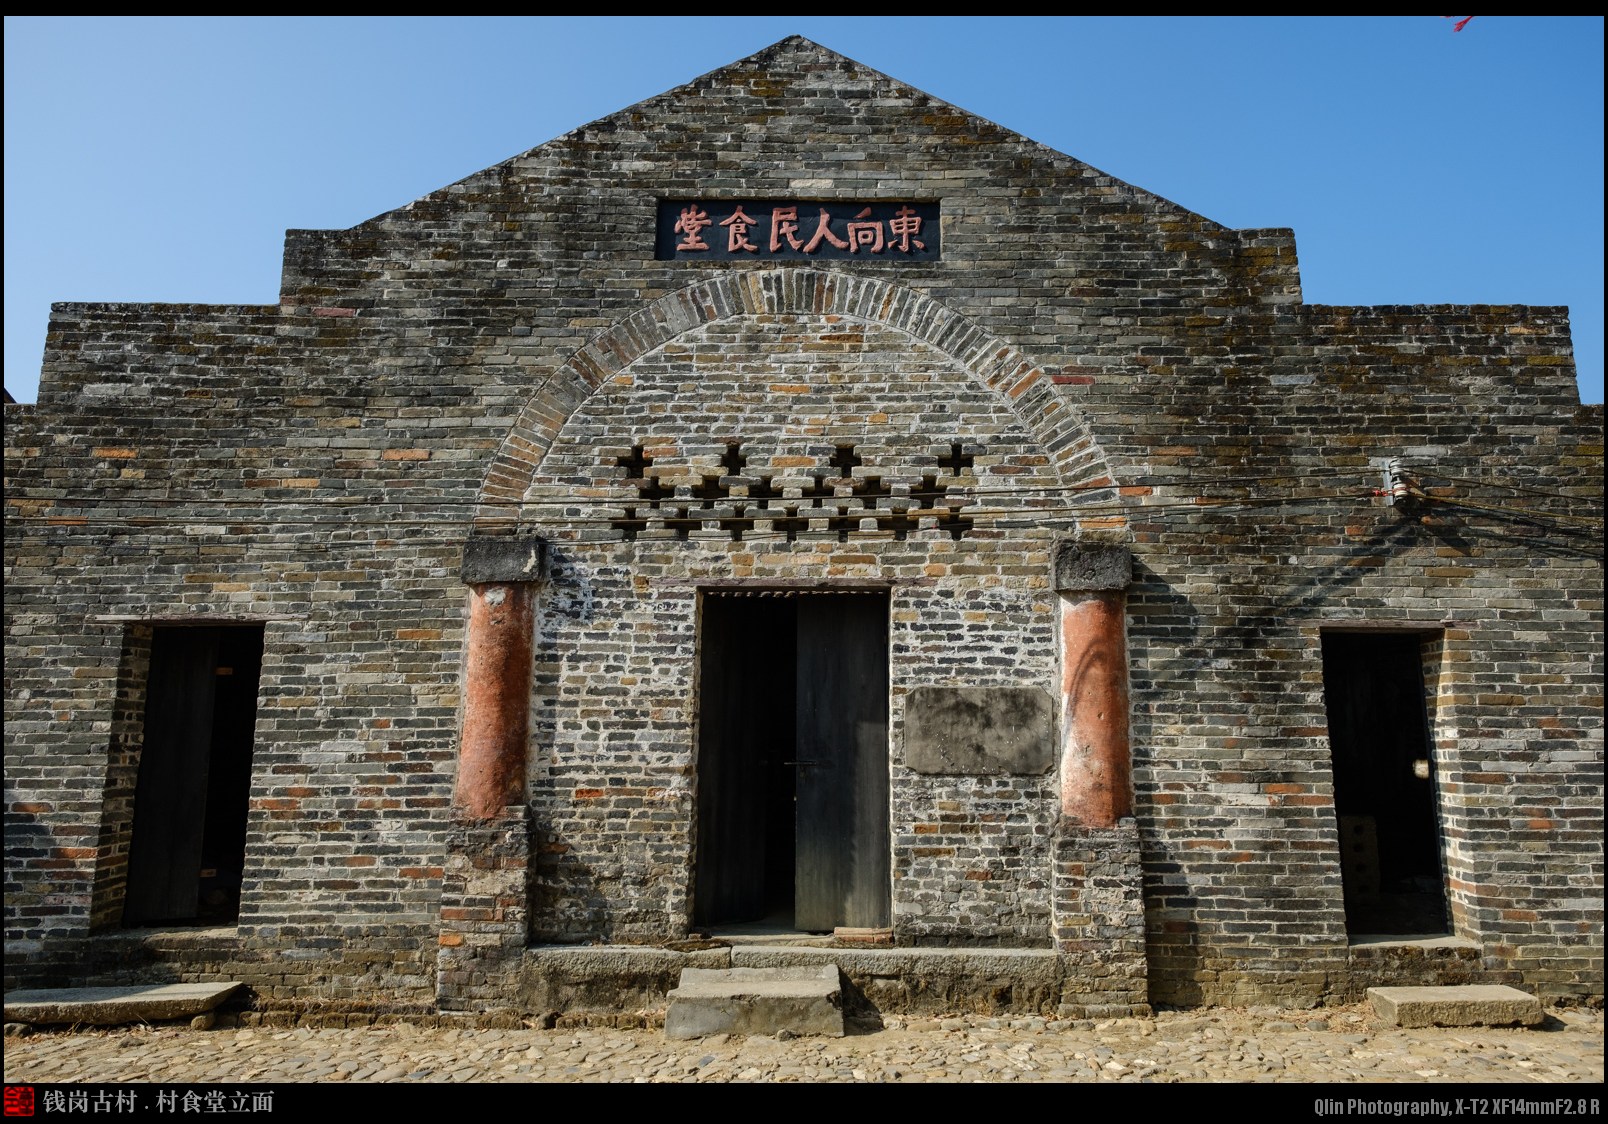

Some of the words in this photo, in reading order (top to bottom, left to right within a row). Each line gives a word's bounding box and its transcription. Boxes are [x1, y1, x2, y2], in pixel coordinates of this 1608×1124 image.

[674, 204, 925, 253] 東向人民食堂
